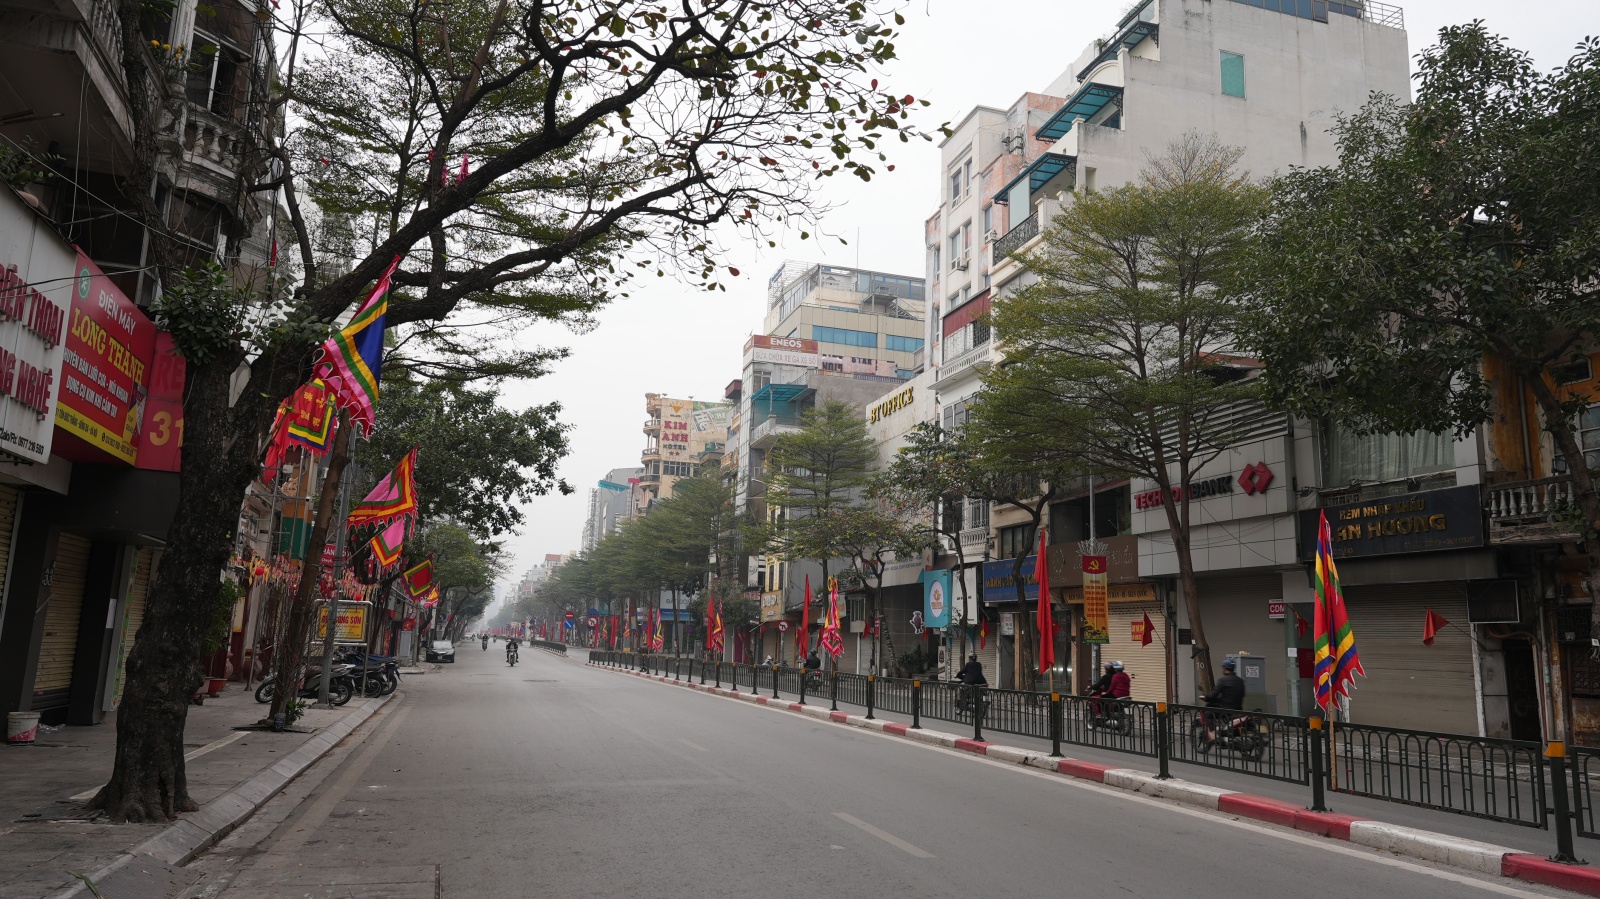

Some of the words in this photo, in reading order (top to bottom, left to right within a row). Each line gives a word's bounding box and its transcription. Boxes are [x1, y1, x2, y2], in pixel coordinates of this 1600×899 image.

[28, 287, 64, 349] THOẠI
[98, 289, 118, 321] ĐIỆN
[118, 309, 137, 336] MÁY
[71, 307, 107, 355] LONG
[108, 335, 145, 385] THÀNH
[770, 337, 802, 348] ENEOS
[792, 355, 800, 363] GA
[16, 359, 53, 421] NGHỆ
[870, 404, 881, 424] BT
[882, 386, 914, 417] OFFICE
[662, 433, 688, 442] ANH
[664, 420, 687, 430] KIM
[1134, 475, 1233, 509] TECHOBANK
[1331, 523, 1361, 543] AN
[1367, 514, 1447, 539] HƯƠNG
